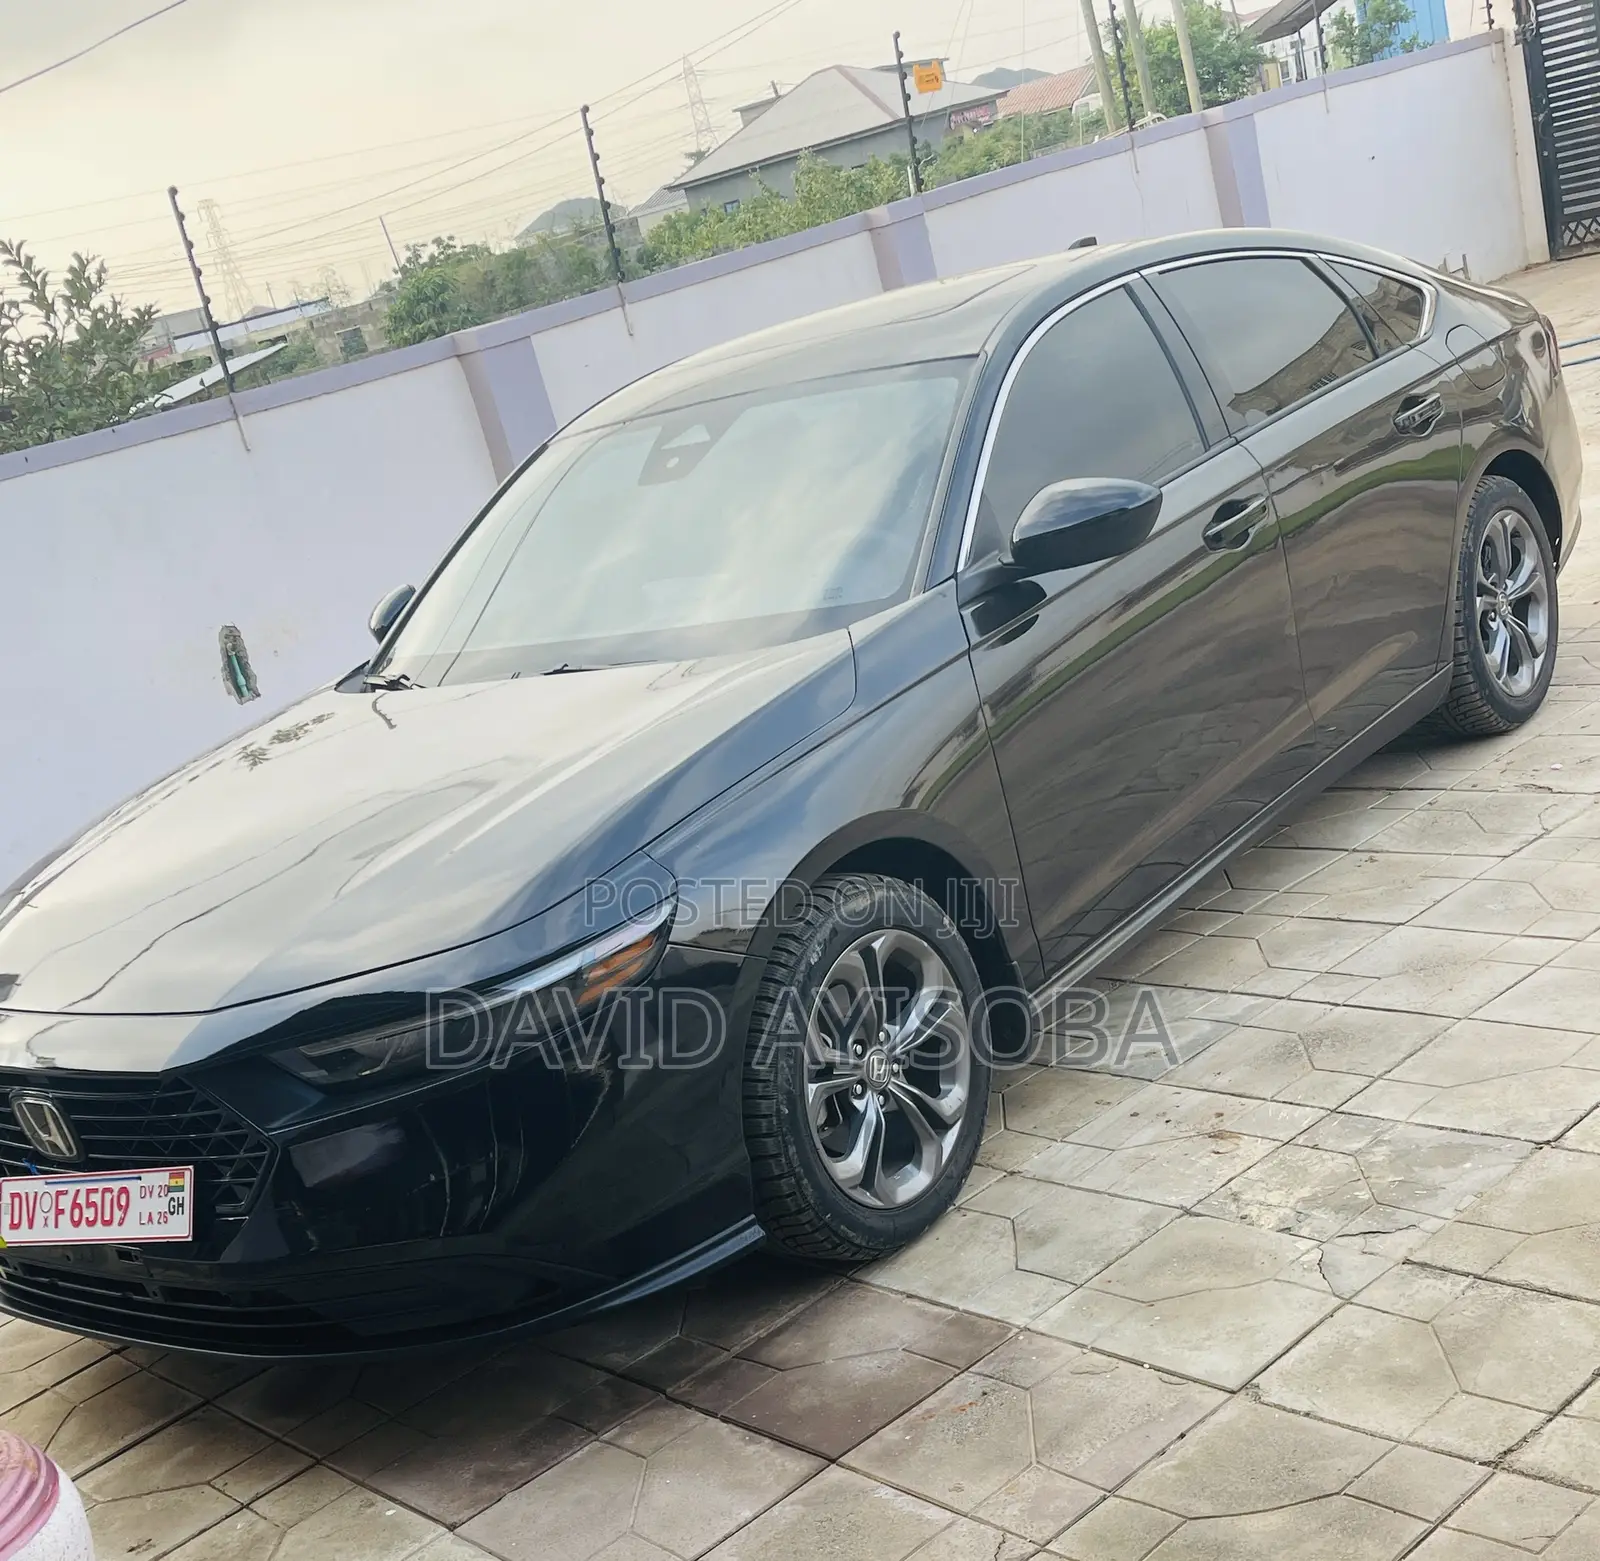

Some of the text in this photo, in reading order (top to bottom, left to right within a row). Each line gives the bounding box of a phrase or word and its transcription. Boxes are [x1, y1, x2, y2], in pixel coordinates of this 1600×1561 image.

[139, 1184, 168, 1199] DV 20
[9, 1186, 130, 1230] DV F6509
[168, 1196, 184, 1216] GH
[139, 1211, 153, 1225] LA
